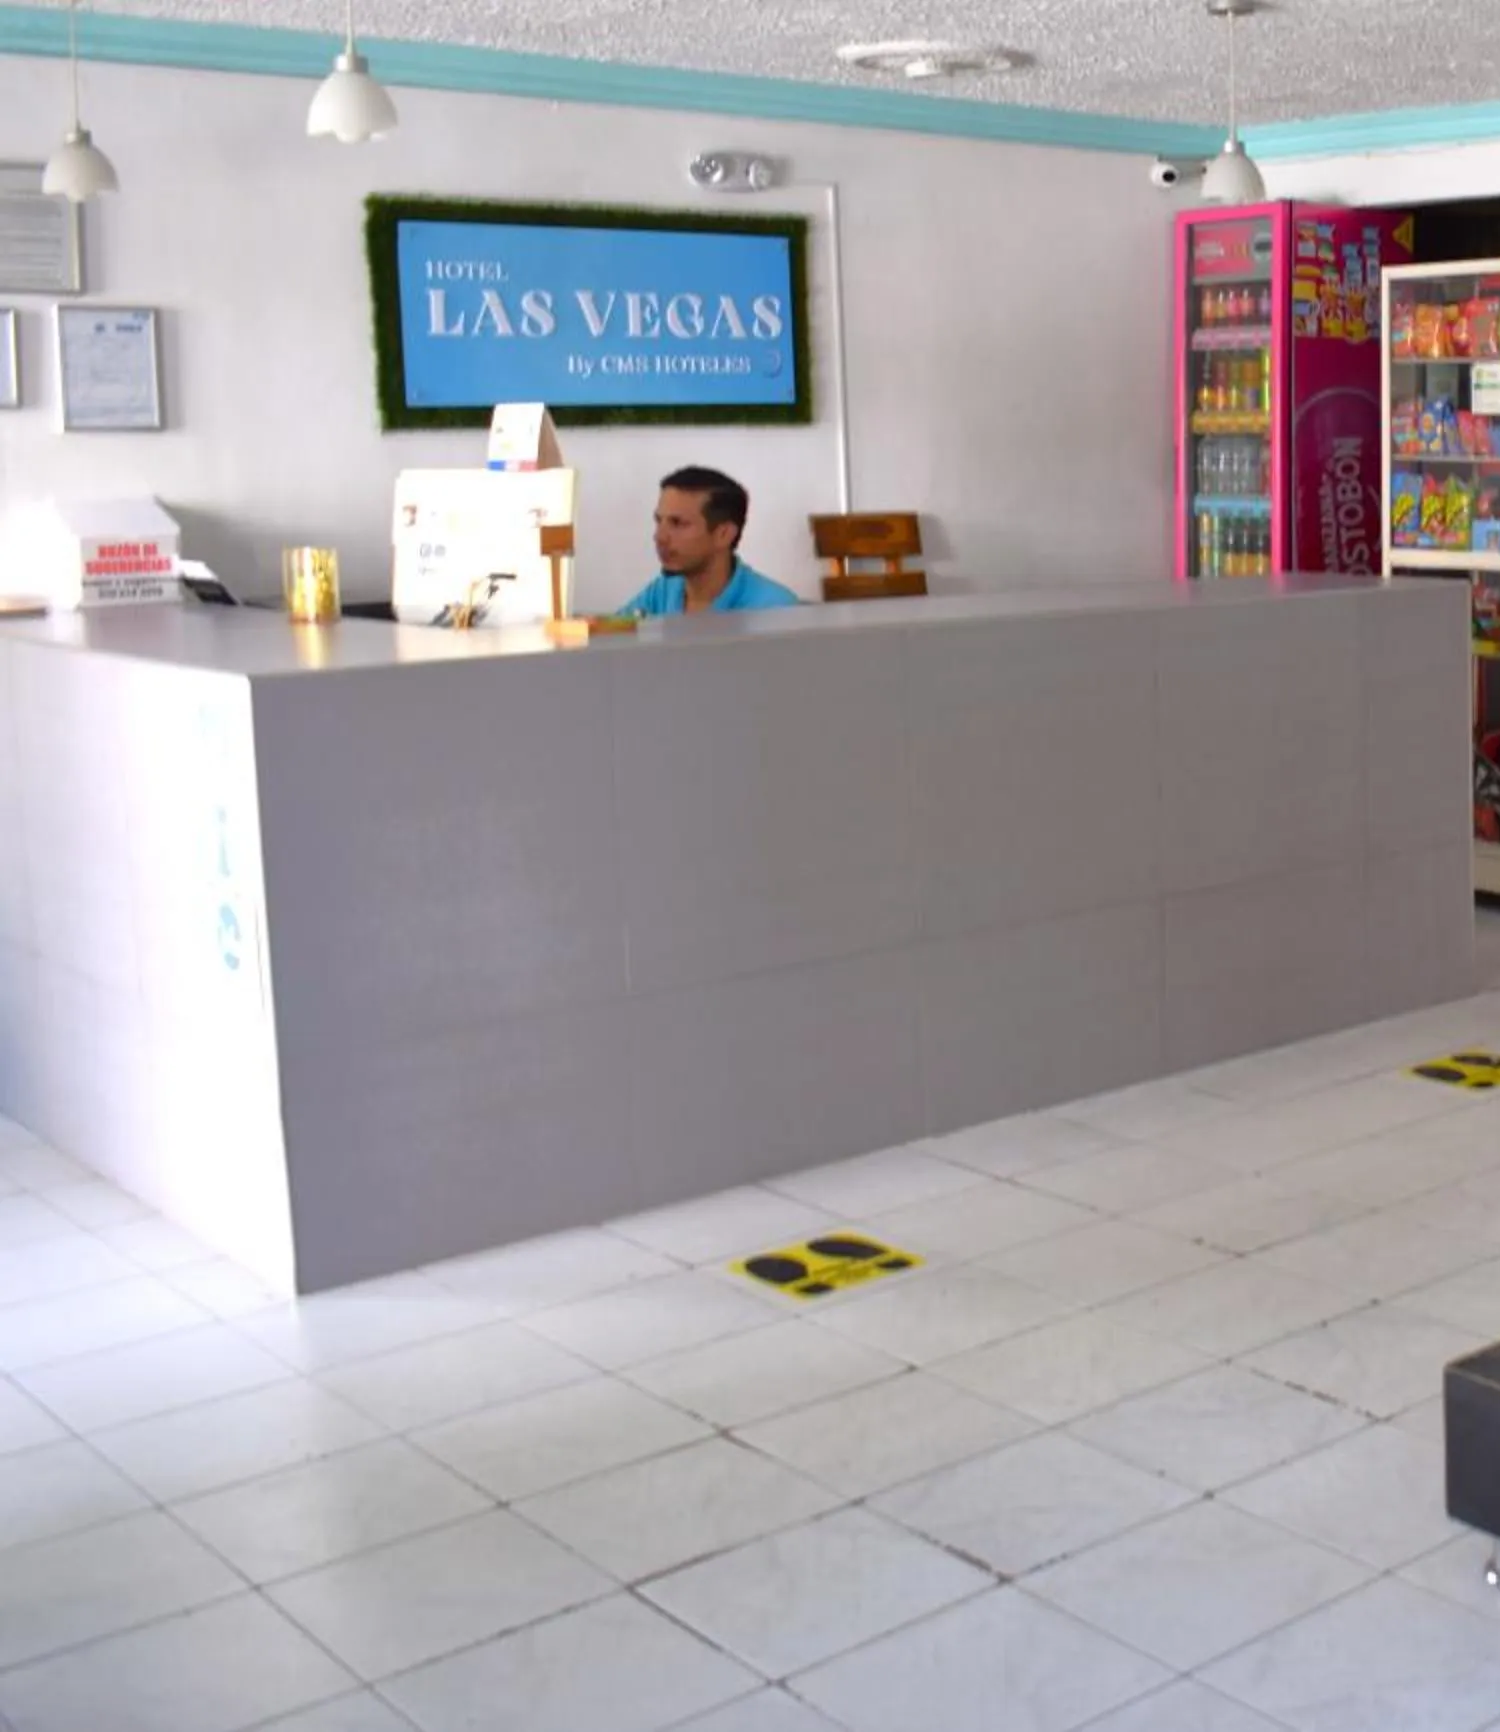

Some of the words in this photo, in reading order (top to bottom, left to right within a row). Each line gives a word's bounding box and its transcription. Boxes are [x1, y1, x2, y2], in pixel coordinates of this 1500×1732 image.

[425, 260, 509, 282] HOTEL
[427, 288, 556, 338] LAS
[574, 288, 783, 340] VEGAS
[567, 354, 595, 380] By
[600, 353, 649, 374] CMS
[654, 355, 751, 375] HOTELES
